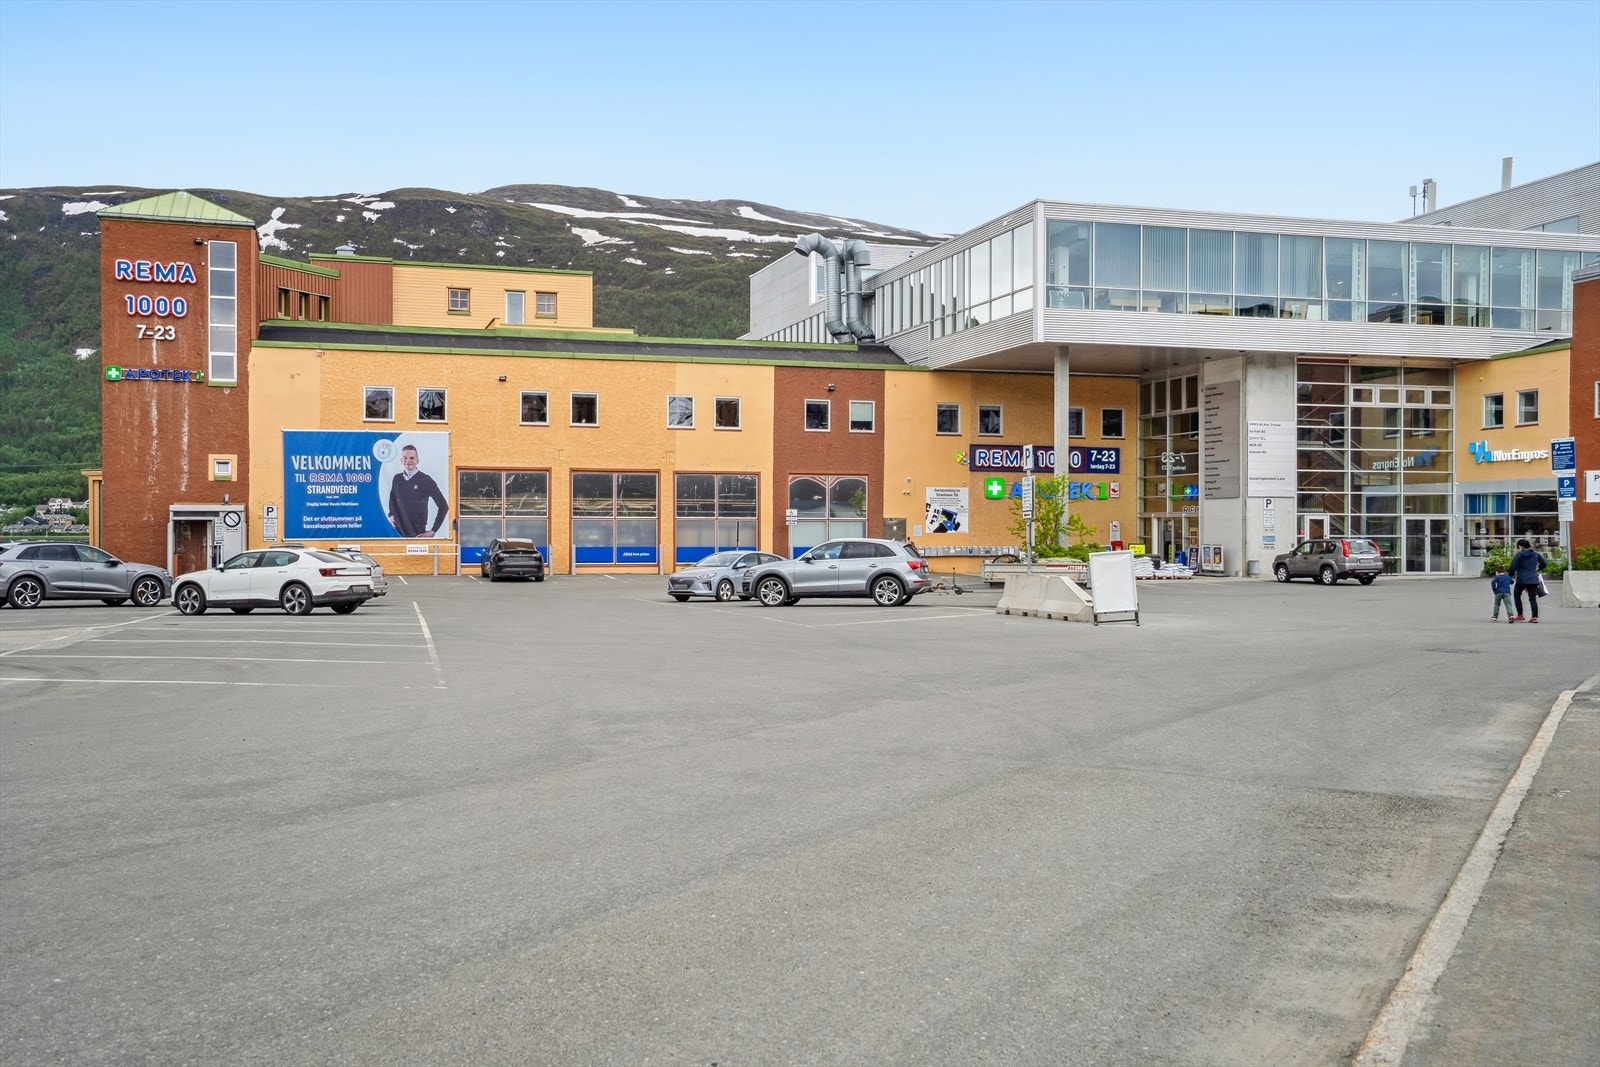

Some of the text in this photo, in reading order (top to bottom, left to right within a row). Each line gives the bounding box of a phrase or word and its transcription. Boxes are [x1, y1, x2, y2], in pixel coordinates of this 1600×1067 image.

[116, 260, 196, 283] REMA
[125, 294, 187, 316] 1000
[136, 325, 176, 340] 7-23
[124, 368, 204, 382] APOTEK 1
[291, 455, 372, 470] VELKOMMEN
[975, 449, 1082, 468] REM 100
[1025, 448, 1031, 466] P
[1091, 450, 1116, 462] 7-23
[1492, 449, 1548, 463] NorEngros
[294, 473, 372, 483] TIL REMA 1000
[1563, 479, 1570, 487] P
[307, 485, 358, 494] STRANDVEGEN
[1096, 482, 1108, 500] 1
[1265, 499, 1272, 508] P
[266, 506, 274, 516] P
[355, 515, 362, 523] på
